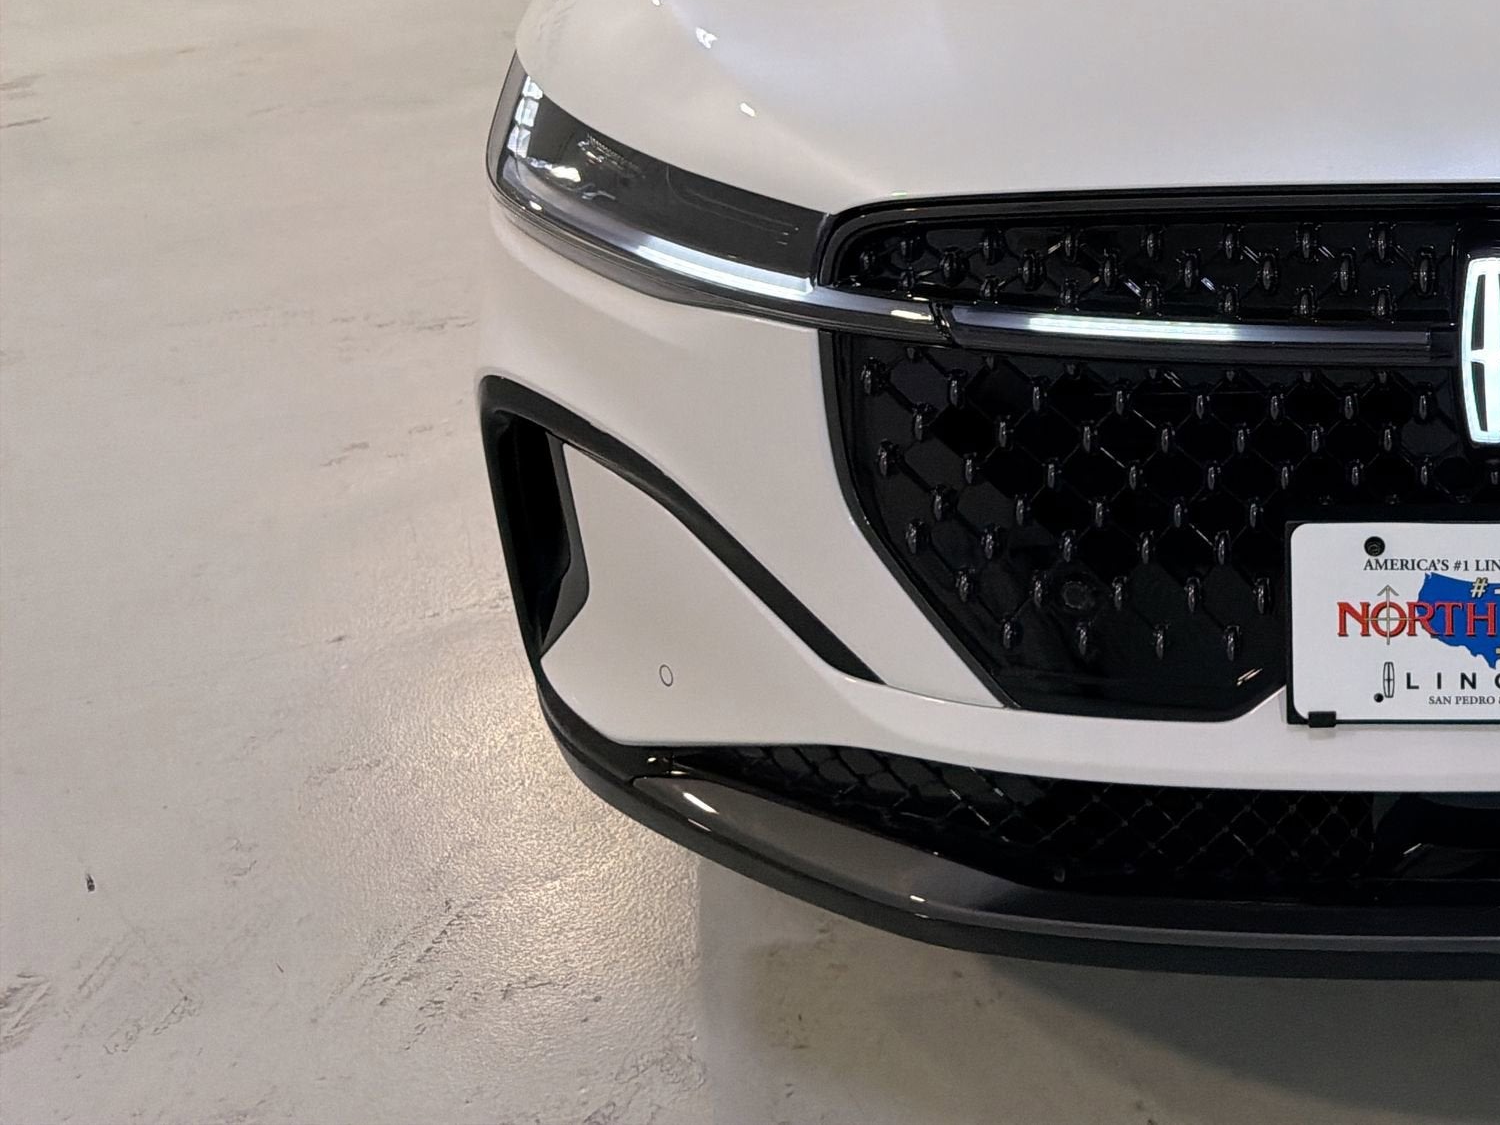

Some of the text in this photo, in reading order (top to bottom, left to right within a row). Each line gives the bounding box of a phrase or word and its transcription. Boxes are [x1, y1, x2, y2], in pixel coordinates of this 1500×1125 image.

[1363, 558, 1449, 572] AMERICA'S
[1453, 559, 1469, 572] #1
[1336, 601, 1498, 638] NORTH
[1428, 695, 1452, 705] SAN
[1455, 695, 1496, 705] PEDRO
